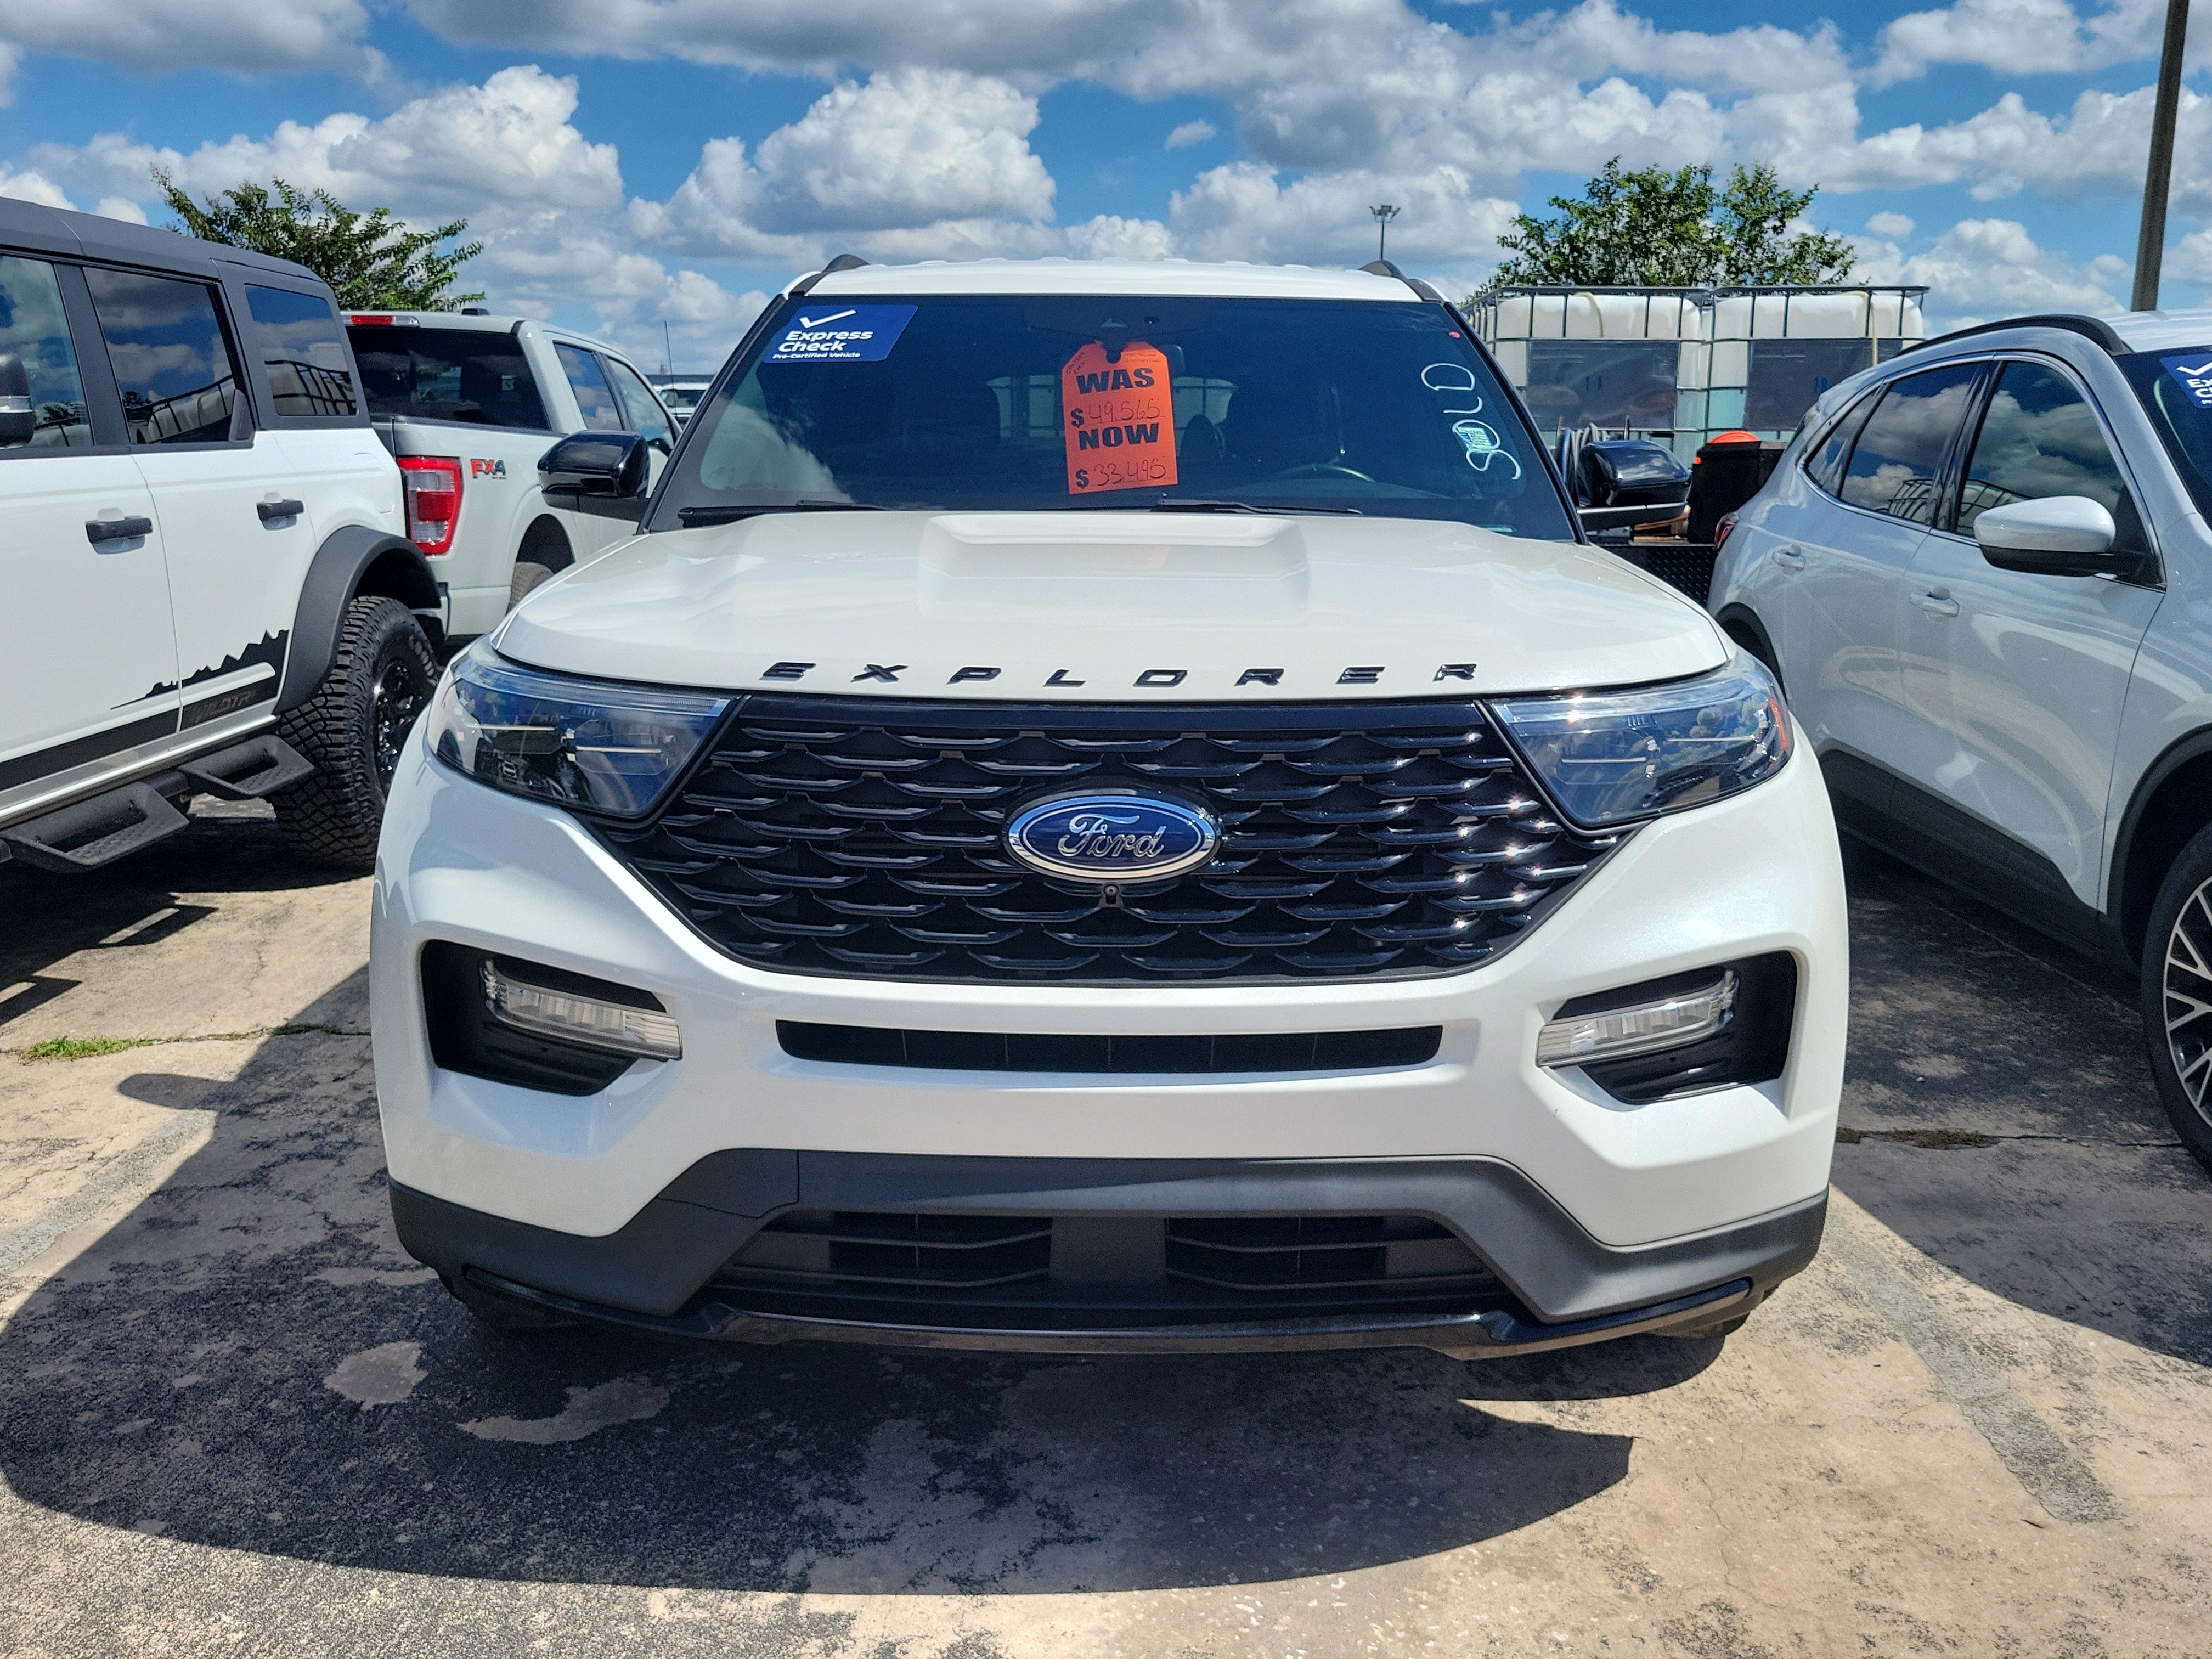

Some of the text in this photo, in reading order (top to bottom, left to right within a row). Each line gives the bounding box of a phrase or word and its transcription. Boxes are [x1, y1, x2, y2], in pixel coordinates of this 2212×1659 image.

[778, 340, 847, 352] Check
[786, 330, 874, 342] Express
[1076, 368, 1154, 394] WAS
[1420, 362, 1522, 481] SOLD
[1079, 422, 1159, 450] NOW
[758, 661, 1477, 687] EXPLORER
[1058, 813, 1167, 858] Ford
